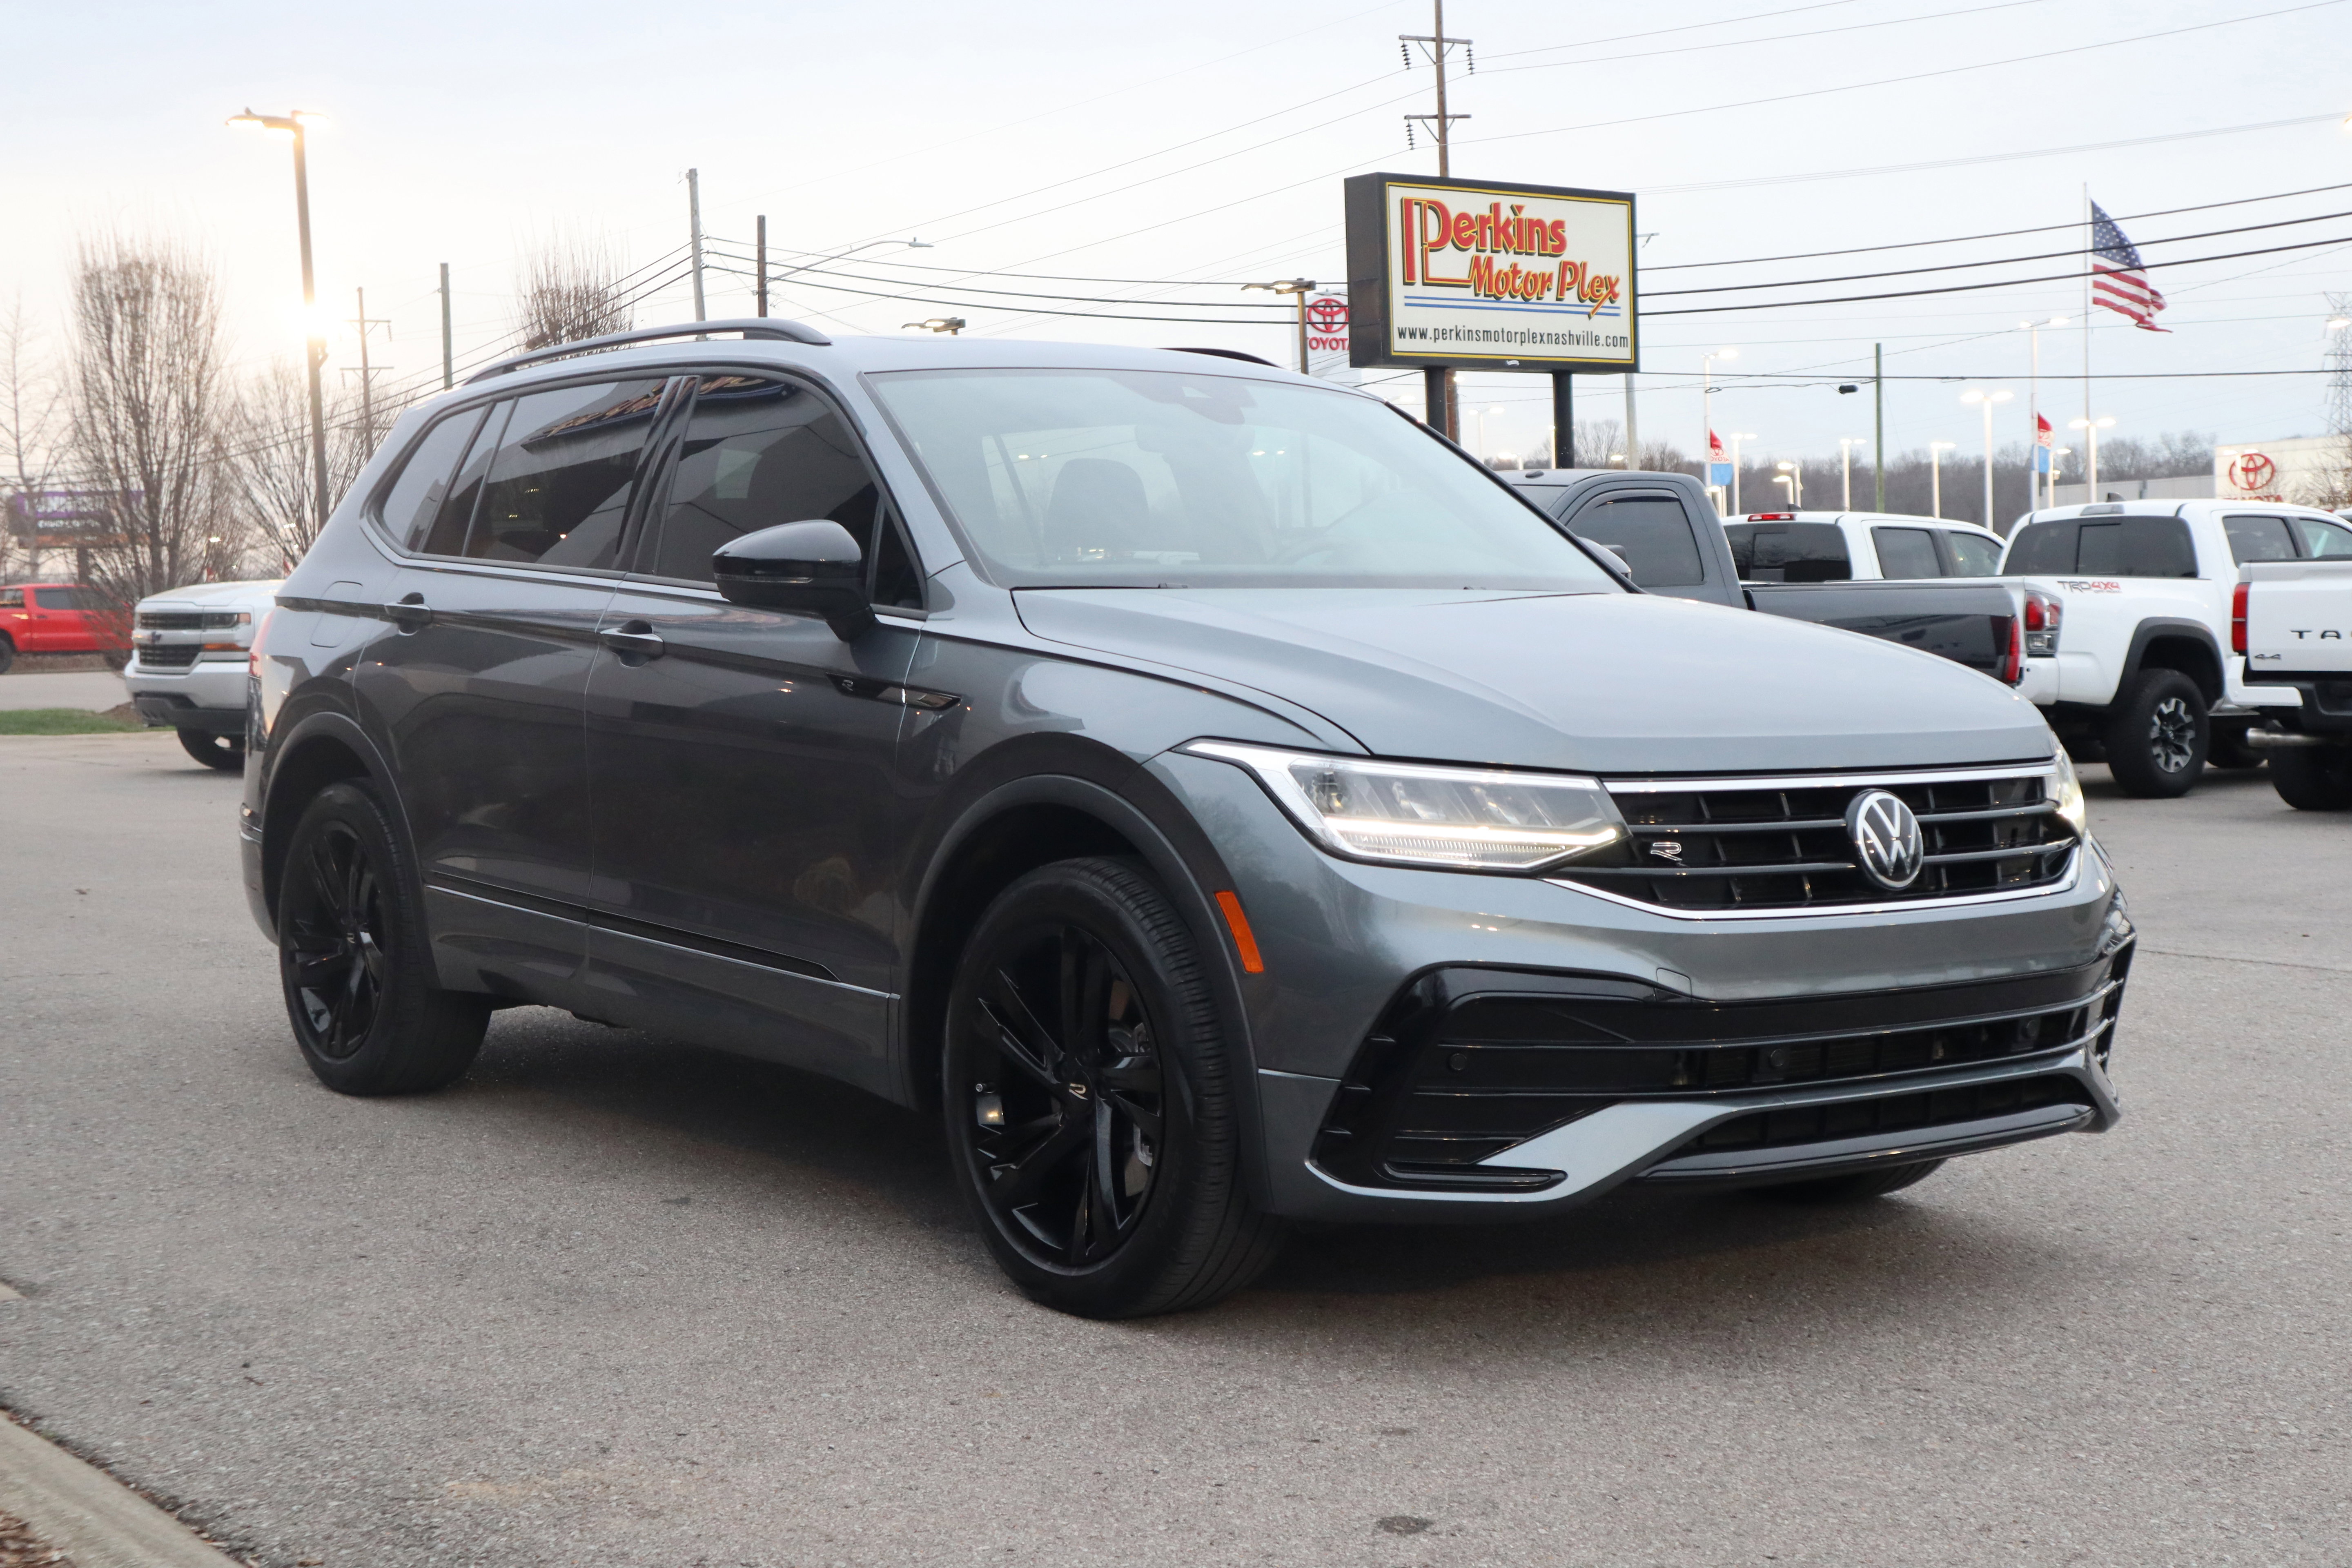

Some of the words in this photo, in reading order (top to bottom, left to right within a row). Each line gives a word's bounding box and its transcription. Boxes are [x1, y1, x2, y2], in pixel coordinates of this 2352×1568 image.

[1401, 196, 1568, 286] Perkins
[1469, 254, 1554, 302] Motor
[1555, 259, 1621, 321] Plex
[1306, 336, 1350, 350] OYOT
[1397, 324, 1629, 348] www.perkinsmotorplexnashville.com
[2290, 630, 2352, 639] TA
